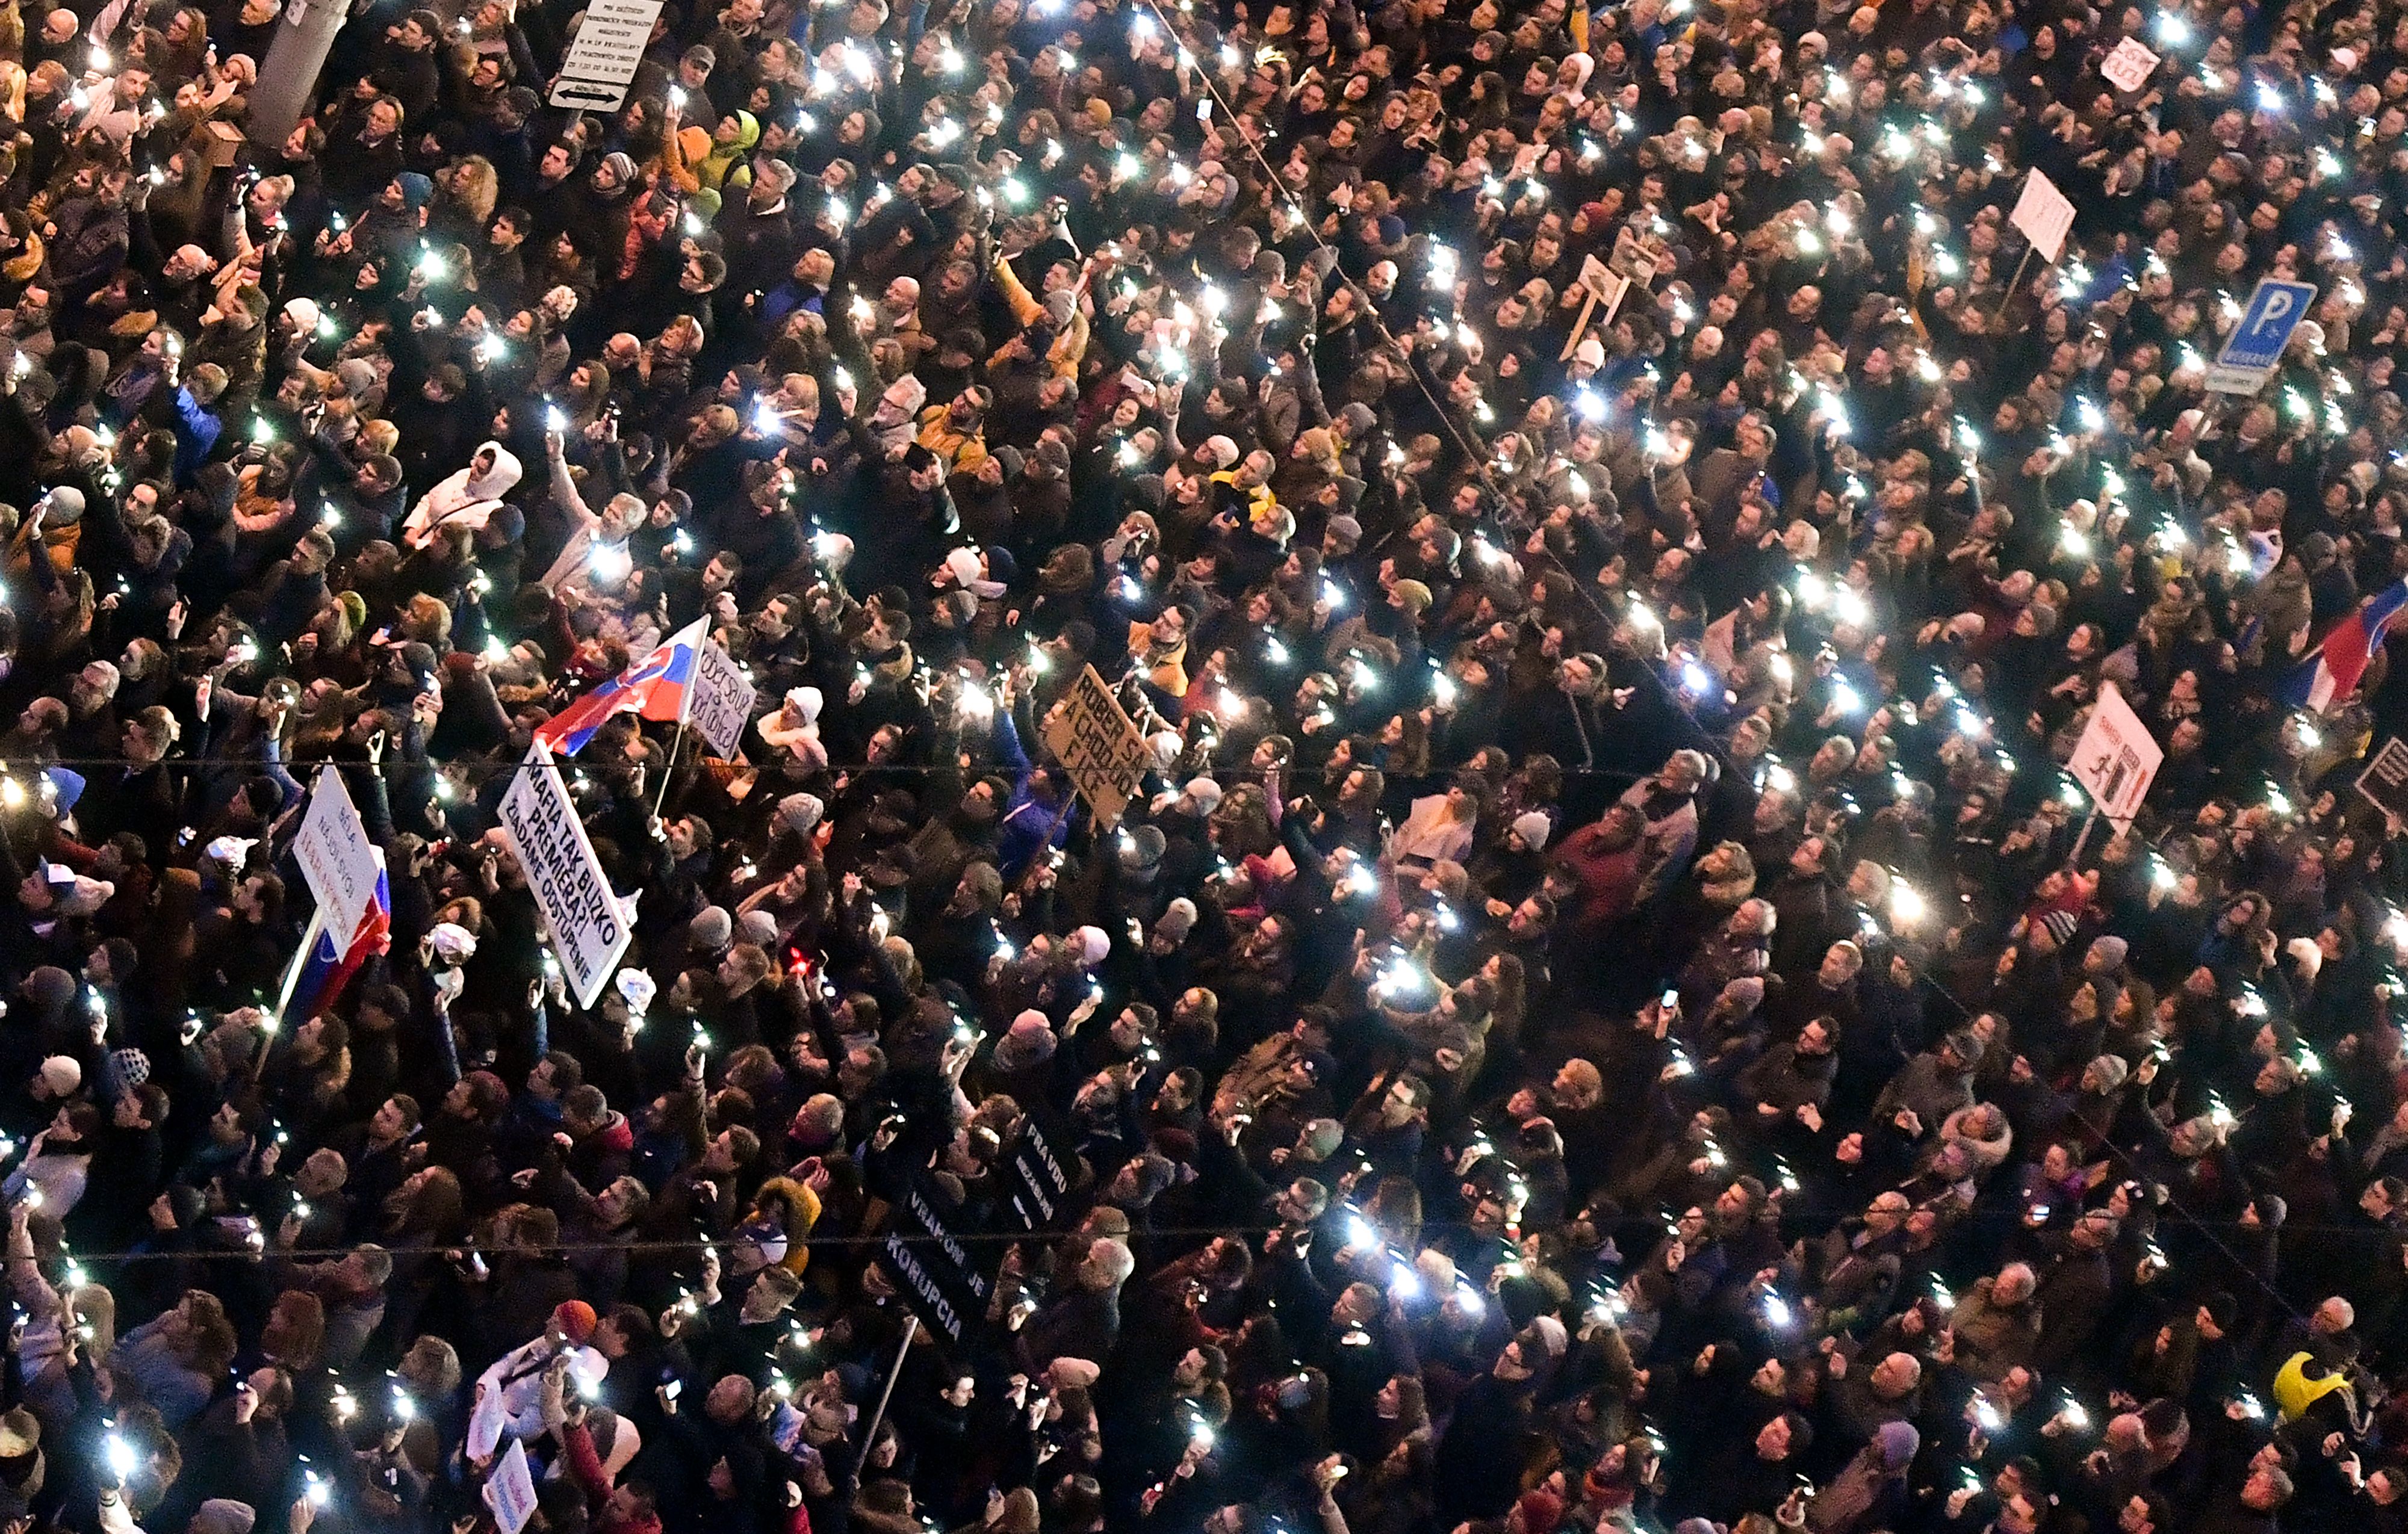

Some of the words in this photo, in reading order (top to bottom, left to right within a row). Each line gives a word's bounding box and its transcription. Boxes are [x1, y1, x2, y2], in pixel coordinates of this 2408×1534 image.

[2252, 290, 2293, 335] P
[1066, 702, 1078, 723] A
[1122, 738, 1144, 775] SA
[527, 756, 562, 830] MAFIA
[559, 823, 584, 876] TAK
[1027, 1123, 1067, 1193] PRAVDU
[911, 1191, 964, 1267] VRAHOM
[968, 1272, 984, 1297] JE
[887, 1232, 962, 1341] KORUPCIA
